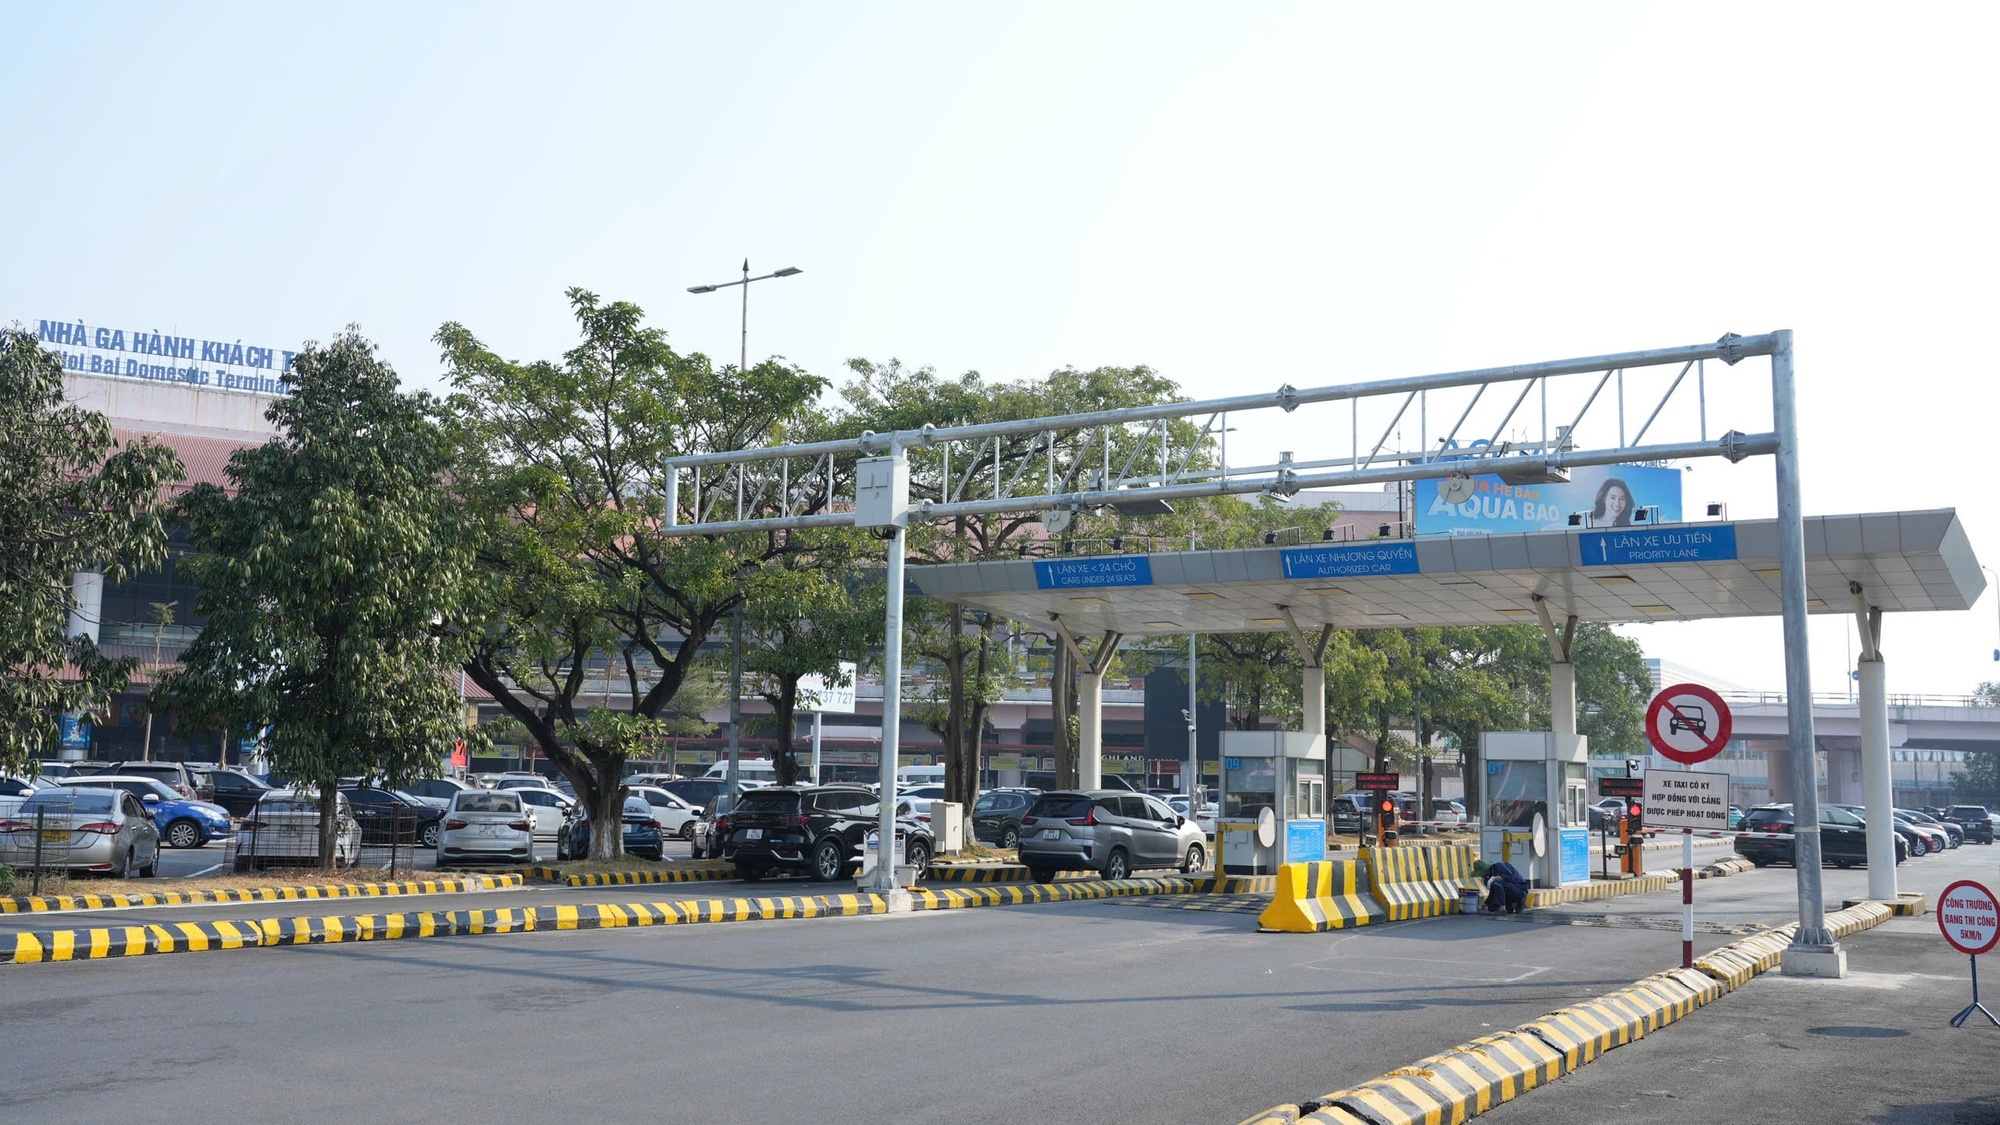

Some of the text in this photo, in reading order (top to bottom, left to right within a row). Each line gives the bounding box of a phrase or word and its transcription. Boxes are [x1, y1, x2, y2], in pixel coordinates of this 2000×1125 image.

[39, 318, 88, 347] NHÀ
[95, 327, 125, 351] GA
[132, 328, 195, 360] HÀNH
[201, 339, 273, 369] KHÁCH
[90, 354, 120, 376] Bai
[126, 358, 210, 385] Domestic
[1522, 501, 1560, 522] BAO
[1613, 535, 1640, 549] LÀN
[1643, 534, 1660, 547] XE
[1685, 531, 1713, 545] TIÊN
[1293, 553, 1314, 565] LÀN
[1315, 553, 1327, 564] XE
[1629, 548, 1700, 560] PRIORITY LANE
[1056, 563, 1076, 575] LÀN
[1078, 563, 1090, 573] XE
[1100, 562, 1111, 572] 24
[1318, 563, 1392, 576] AUTHORIZED CAR
[1061, 573, 1137, 585] CARS UNDER 24 SEATS
[837, 692, 854, 705] 727
[1226, 757, 1240, 770] 09
[1487, 760, 1503, 775] 01
[1662, 780, 1672, 788] XE
[1673, 780, 1688, 789] TAXI
[1689, 780, 1699, 790] CÓ
[1651, 793, 1666, 804] HỢP
[1646, 807, 1665, 818] ĐƯỢC
[1666, 807, 1685, 817] PHÉP
[1686, 809, 1705, 820] HOẠT
[1945, 897, 1964, 909] CÔNG
[1944, 914, 1996, 927] ĐANG THI CÔNG
[1960, 929, 1982, 941] 5KM/h
